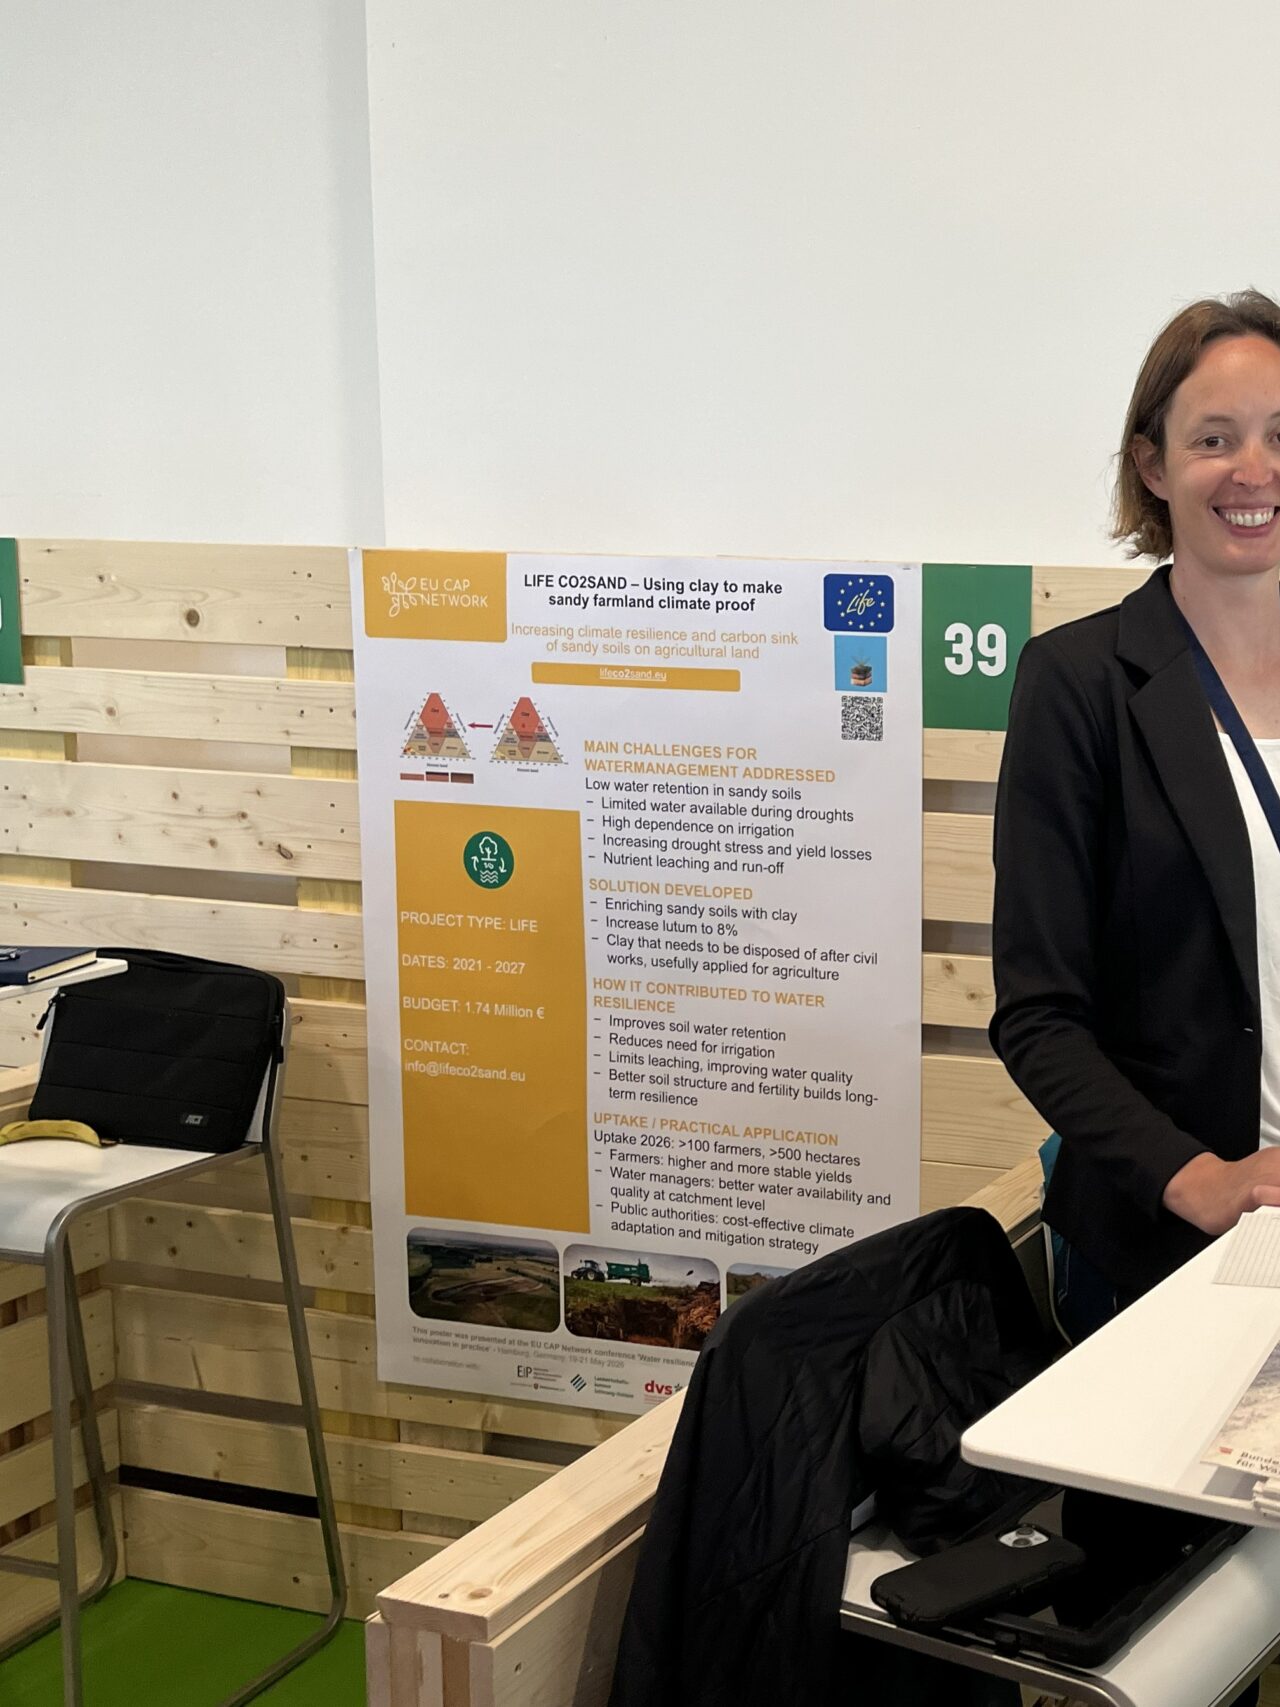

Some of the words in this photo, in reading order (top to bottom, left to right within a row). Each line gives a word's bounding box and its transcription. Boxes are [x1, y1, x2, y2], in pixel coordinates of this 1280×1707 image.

[420, 577, 438, 591] EU
[443, 578, 470, 591] CAP
[524, 574, 554, 587] LIFE
[558, 574, 627, 589] CO2SAND
[643, 577, 684, 594] Using
[688, 578, 719, 595] clay
[723, 580, 738, 593] to
[742, 580, 782, 594] make
[420, 592, 488, 608] NETWORK
[548, 593, 589, 609] sandy
[592, 593, 654, 608] farmland
[658, 595, 711, 610] climate
[715, 598, 755, 613] proof
[846, 589, 876, 616] Life
[511, 622, 574, 640] Increasing
[577, 625, 622, 643] climate
[626, 627, 687, 645] resilience
[691, 629, 716, 642] and
[720, 629, 767, 643] carbon
[770, 631, 798, 645] sink
[546, 638, 558, 651] of
[558, 638, 599, 656] sandy
[602, 641, 630, 654] soils
[634, 644, 650, 655] on
[654, 643, 726, 659] agricultural
[730, 645, 759, 659] land
[945, 622, 1007, 677] 39
[584, 739, 618, 753] MAIN
[623, 742, 722, 758] CHALLENGES
[726, 746, 757, 760] FOR
[584, 758, 739, 778] WATERMANAGEMENT
[742, 766, 835, 782] ADDRESSED
[585, 777, 610, 790] Low
[613, 780, 649, 792] water
[652, 781, 709, 795] retention
[713, 783, 724, 796] in
[728, 785, 768, 802] sandy
[771, 787, 801, 800] soils
[602, 814, 630, 831] High
[634, 817, 714, 833] dependence
[717, 824, 734, 834] on
[738, 822, 794, 839] irrigation
[589, 878, 660, 894] SOLUTION
[664, 882, 753, 900] DEVELOPED
[400, 911, 464, 927] PROJECT
[466, 914, 505, 930] TYPE:
[510, 918, 538, 932] LIFE
[606, 915, 659, 931] Increase
[662, 919, 697, 933] lutum
[700, 922, 713, 935] to
[716, 922, 738, 936] 8%
[402, 953, 448, 971] DATES:
[452, 957, 481, 971] 2021
[495, 960, 525, 974] 2027
[592, 977, 626, 991] HOW
[630, 980, 642, 992] IT
[646, 981, 747, 1001] CONTRIBUTED
[751, 990, 770, 1003] TO
[774, 991, 824, 1007] WATER
[402, 994, 460, 1012] BUDGET:
[465, 1001, 490, 1014] 1.74
[494, 1003, 533, 1018] Million
[536, 1006, 544, 1019] €
[593, 995, 675, 1013] RESILIENCE
[404, 1038, 469, 1055] CONTACT:
[404, 1060, 526, 1082] info@lifeco2sand.eu
[594, 1129, 637, 1145] Uptake
[640, 1133, 674, 1148] 2026:
[678, 1138, 710, 1152] >100
[713, 1140, 765, 1159] farmers,
[769, 1147, 801, 1161] >500
[805, 1149, 860, 1166] hectares
[644, 1380, 673, 1395] dvs
